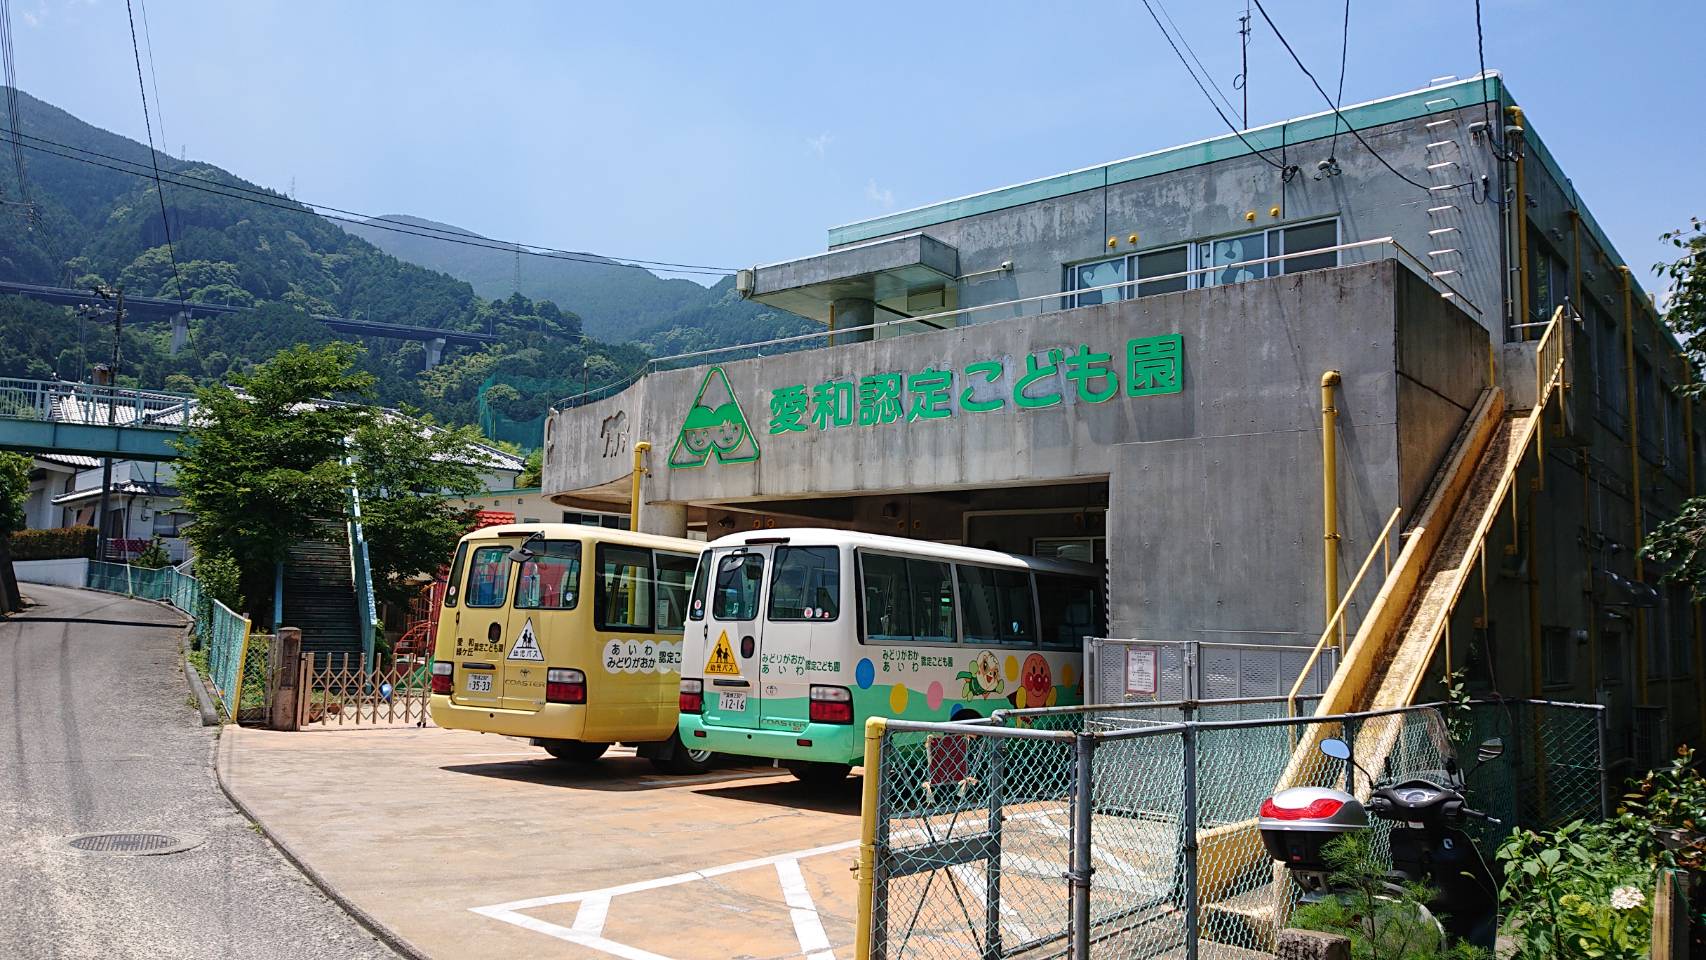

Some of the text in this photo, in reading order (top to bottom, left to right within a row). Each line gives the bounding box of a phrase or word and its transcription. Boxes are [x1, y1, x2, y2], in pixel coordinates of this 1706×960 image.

[769, 333, 1184, 434] 愛和認定こども園
[513, 649, 539, 658] 幼児バス
[762, 653, 806, 665] みどりがおか
[882, 649, 919, 661] みどりがおか
[606, 656, 656, 669] みどりがおか
[710, 663, 735, 672] 幼児バス
[805, 660, 841, 672] 認定こども園
[921, 656, 954, 668] 認定こども園
[505, 679, 546, 688] COASTER
